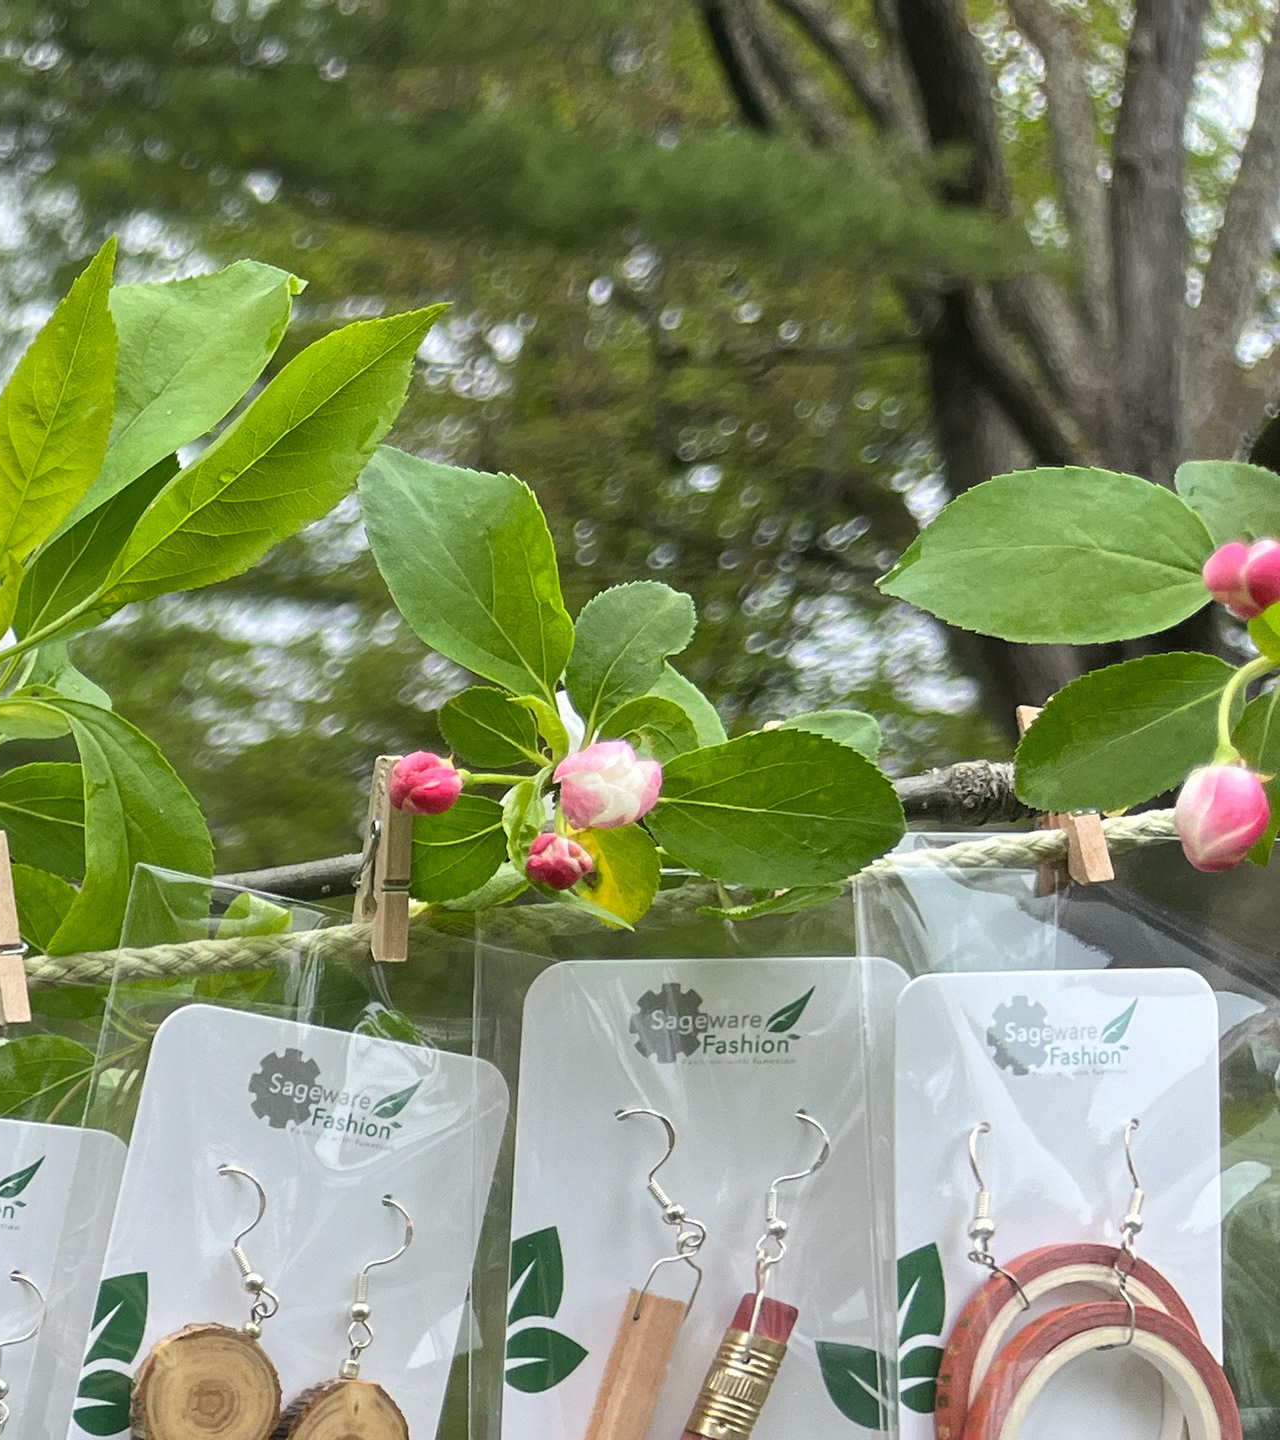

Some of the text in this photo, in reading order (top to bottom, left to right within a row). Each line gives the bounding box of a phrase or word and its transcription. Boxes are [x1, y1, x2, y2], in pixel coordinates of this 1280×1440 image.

[651, 1010, 762, 1035] Sageware
[1005, 1022, 1098, 1047] Sageware
[703, 1034, 789, 1054] Fashion
[1049, 1045, 1121, 1066] Fashion
[269, 1072, 371, 1110] Sageware
[311, 1107, 392, 1140] Fashion
